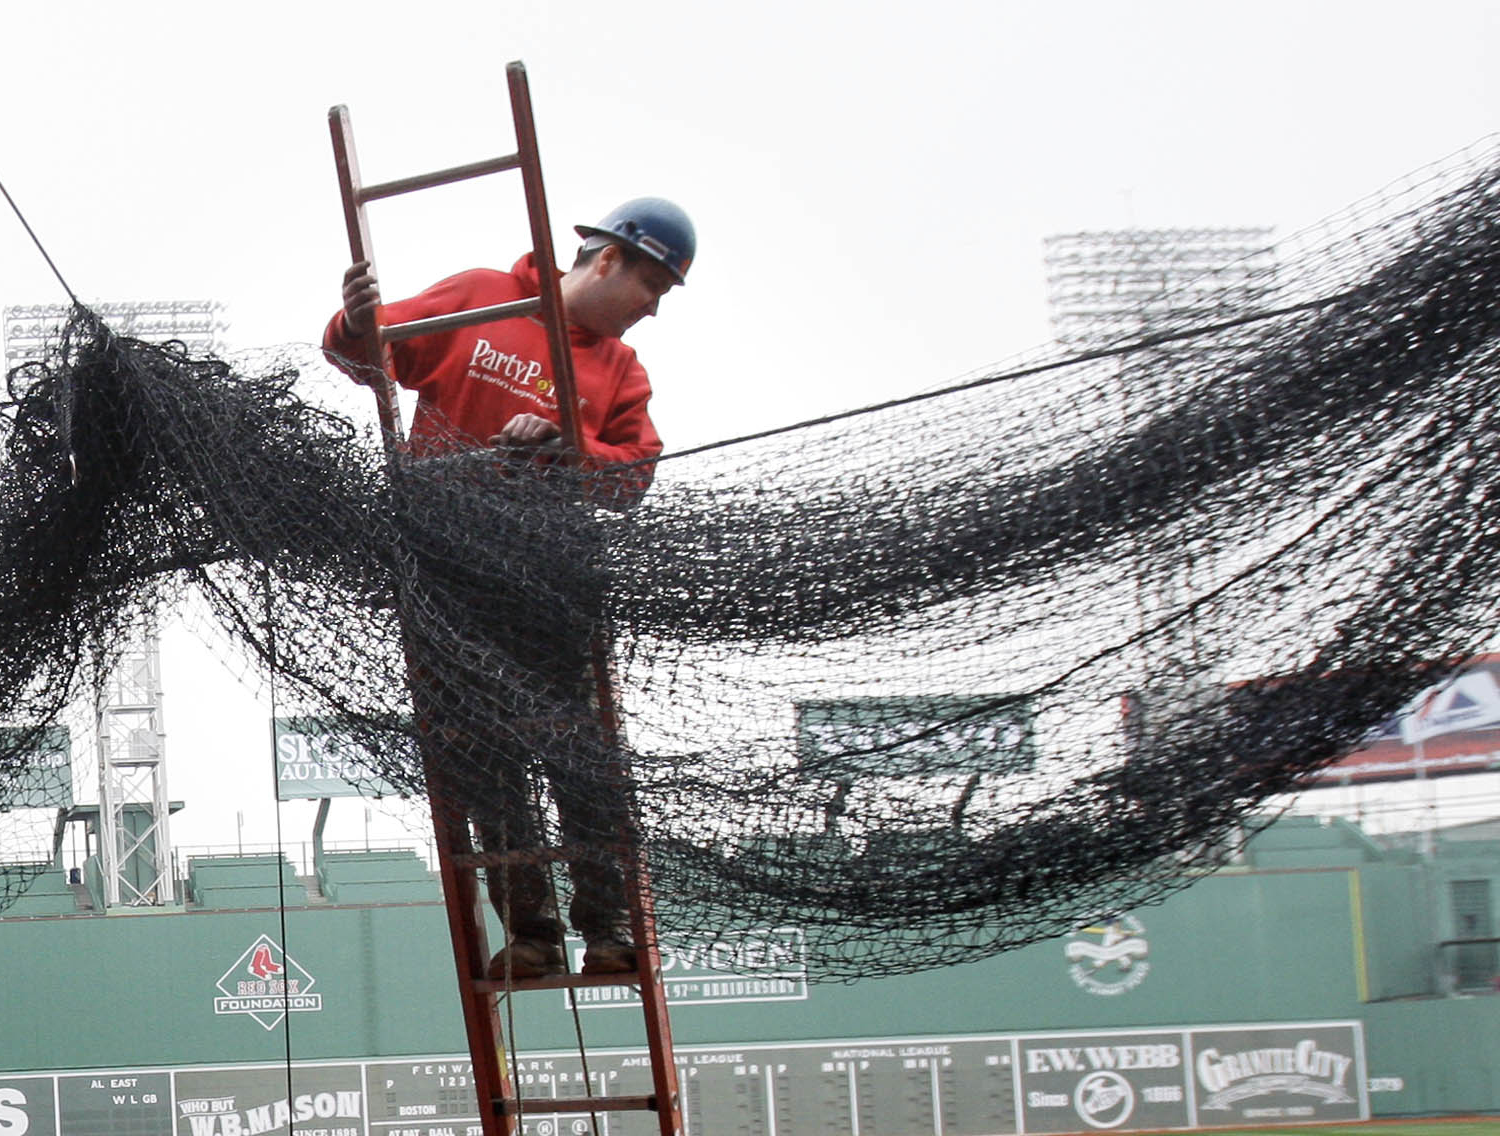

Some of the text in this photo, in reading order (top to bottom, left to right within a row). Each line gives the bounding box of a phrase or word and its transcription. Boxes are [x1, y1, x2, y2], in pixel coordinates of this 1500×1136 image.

[237, 979, 299, 996] RED SOX
[220, 997, 316, 1011] FOUNDATION
[621, 1053, 744, 1067] AMEAN LEAGUE
[1085, 1043, 1181, 1069] WEBB
[90, 1078, 138, 1089] AL EAST
[386, 1079, 394, 1089] P
[459, 1076, 467, 1086] 3
[559, 1072, 569, 1082] R
[112, 1094, 158, 1105] W L GB
[180, 1099, 235, 1114] WHO BUT
[399, 1104, 437, 1116] BOSTON
